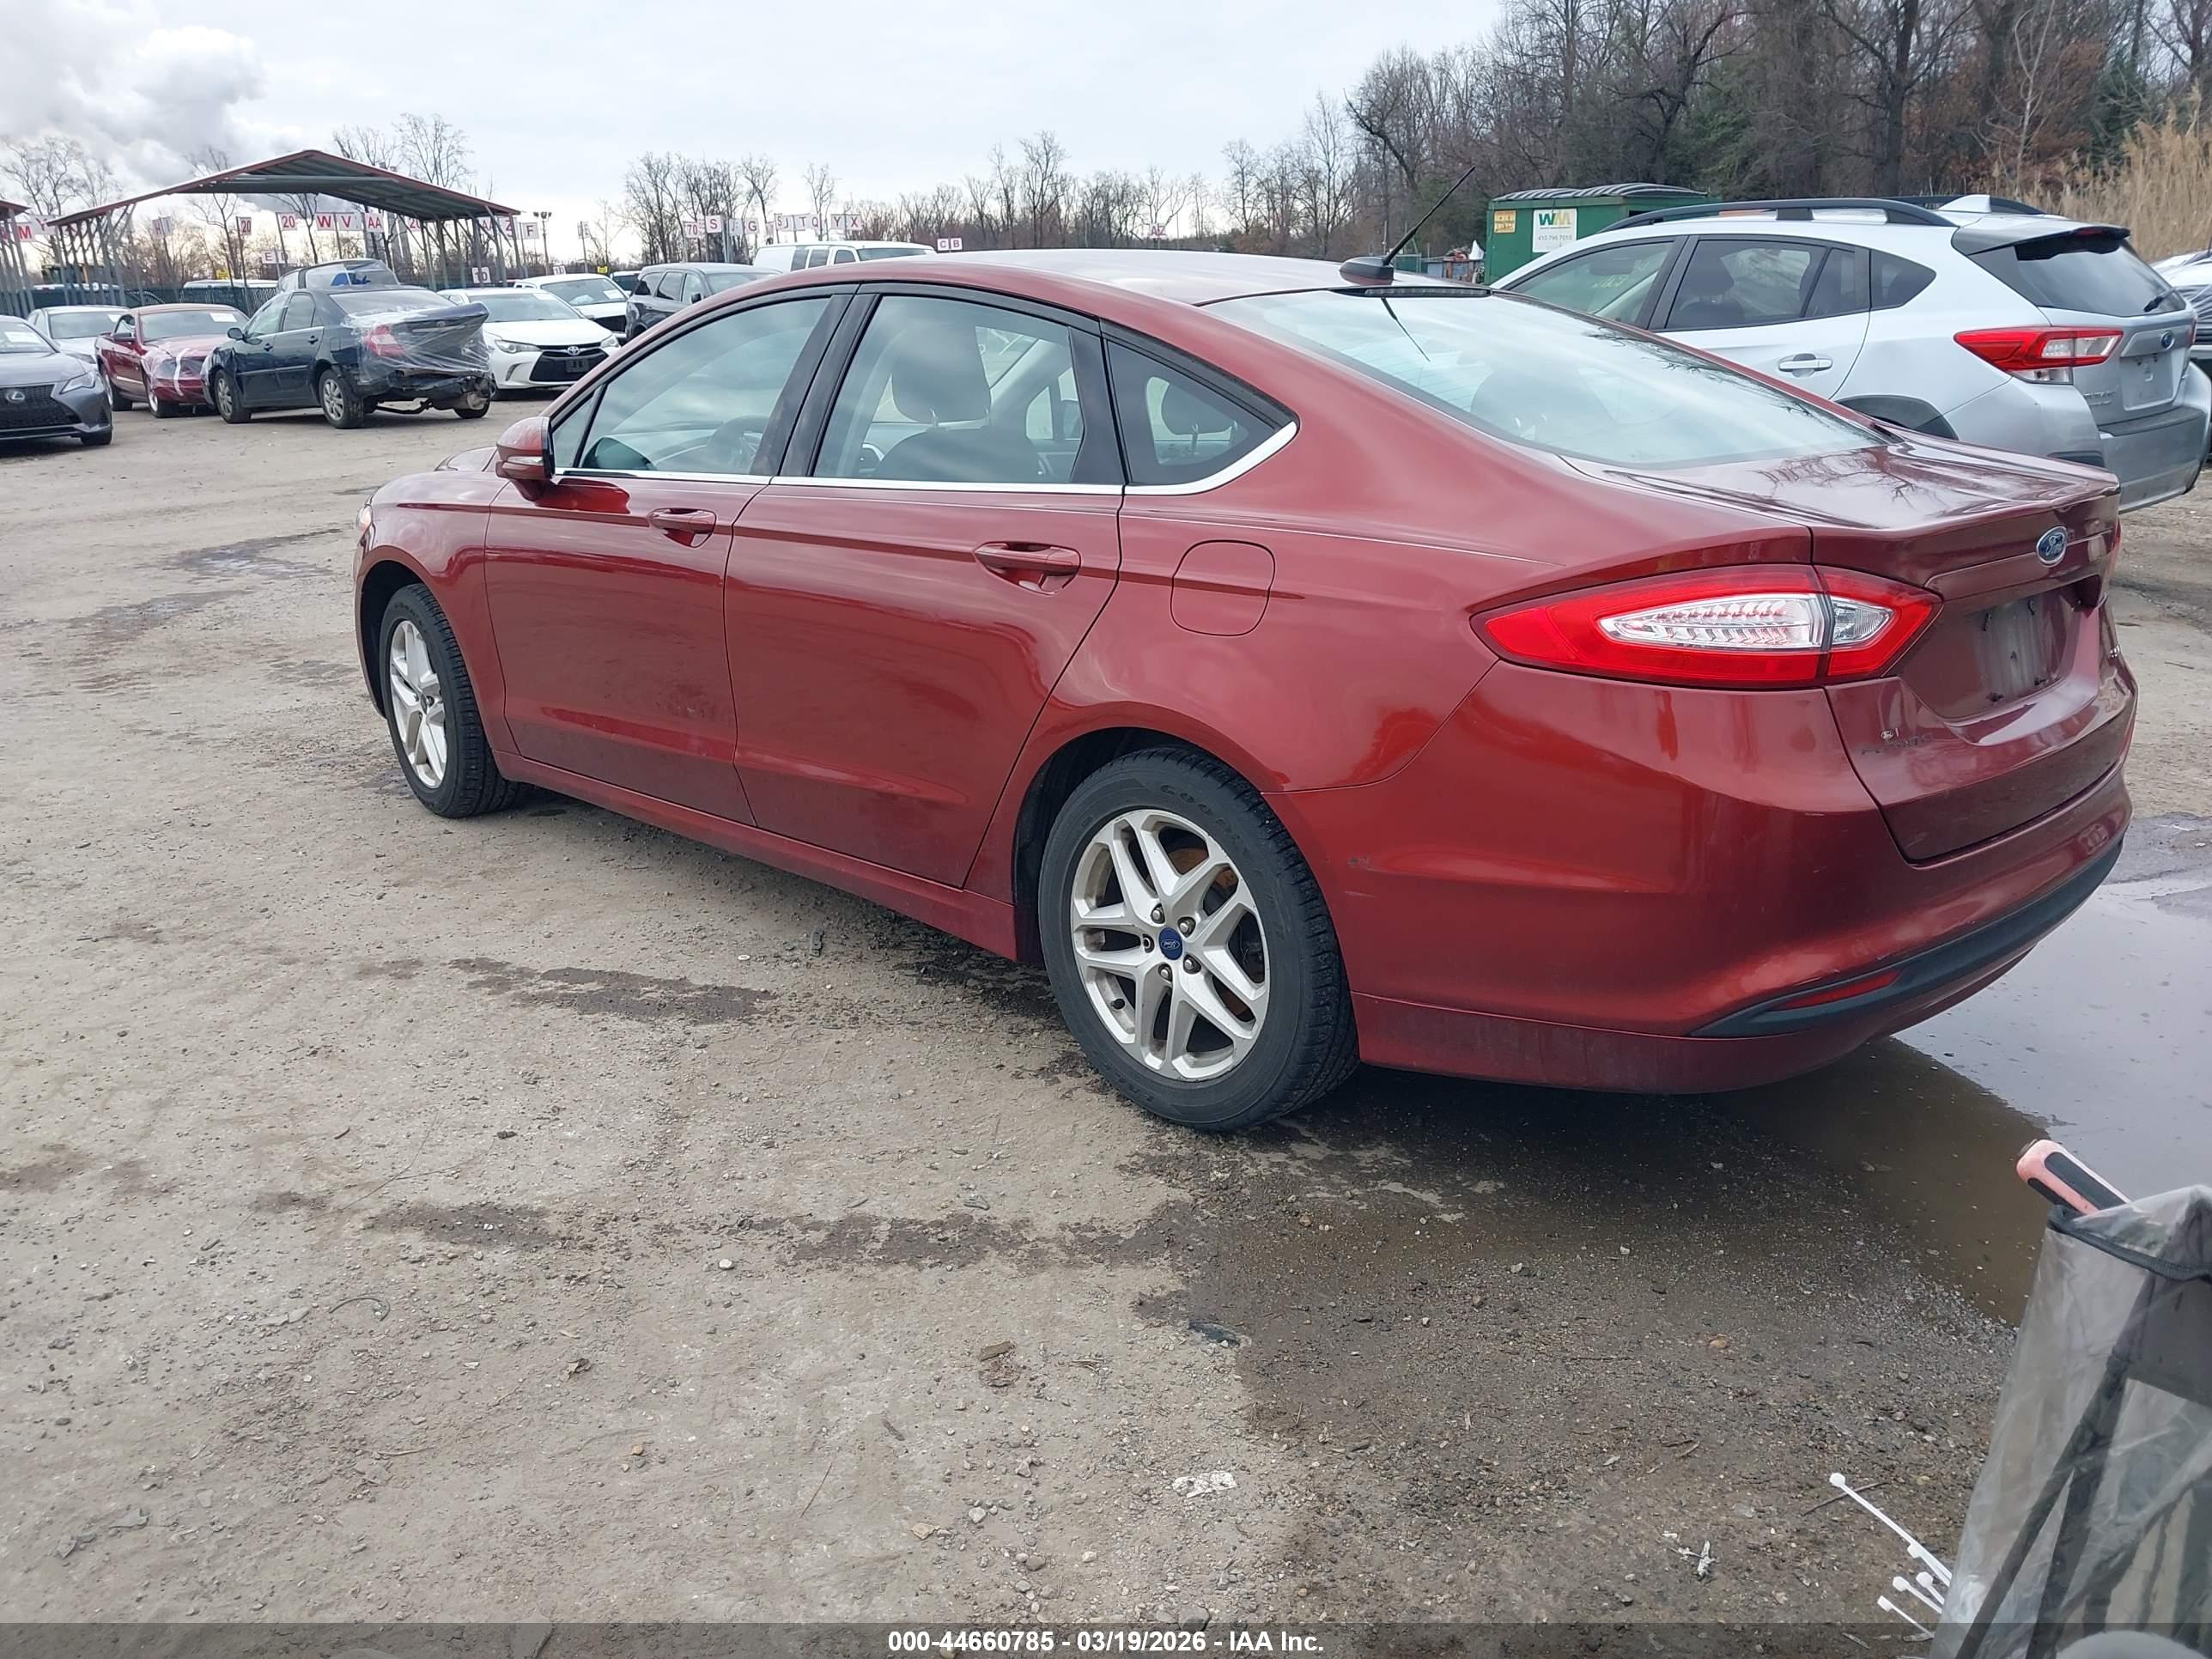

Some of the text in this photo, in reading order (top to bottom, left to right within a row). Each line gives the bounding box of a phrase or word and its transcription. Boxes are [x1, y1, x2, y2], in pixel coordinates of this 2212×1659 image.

[282, 216, 295, 228] 20
[317, 216, 351, 228] W V
[368, 217, 383, 228] AA
[709, 218, 718, 230] S
[834, 216, 858, 227] Y X
[1539, 213, 1571, 225] WM
[240, 220, 251, 233] 20
[526, 225, 533, 237] F
[686, 224, 698, 235] 70
[748, 220, 757, 232] G
[19, 225, 33, 240] M
[953, 240, 960, 248] B
[264, 252, 271, 261] E
